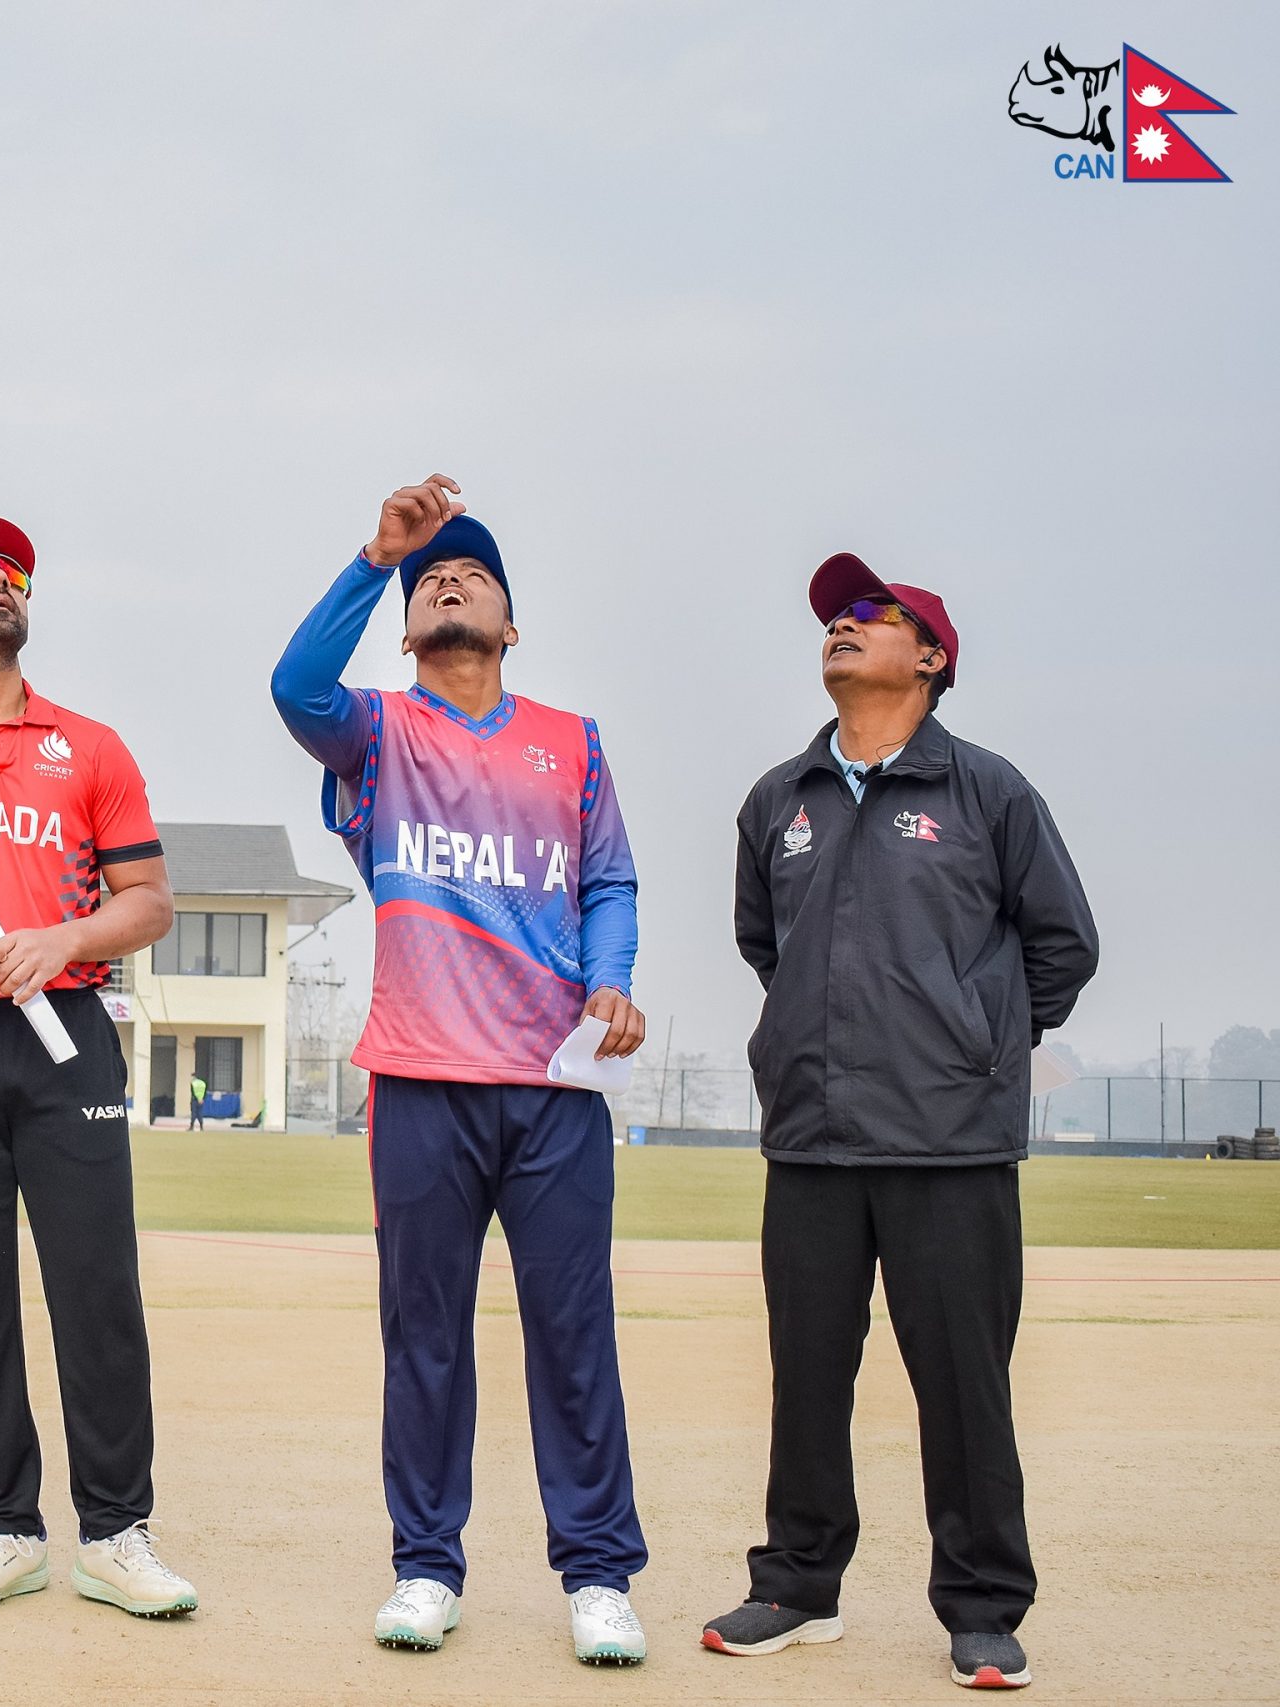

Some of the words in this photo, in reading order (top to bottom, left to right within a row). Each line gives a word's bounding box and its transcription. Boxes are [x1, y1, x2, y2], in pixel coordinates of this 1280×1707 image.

[33, 762, 74, 776] CRICKET
[39, 771, 67, 780] CANADA
[901, 830, 916, 838] CAN
[396, 819, 526, 888] NEPAL
[81, 1104, 125, 1120] YASHI
